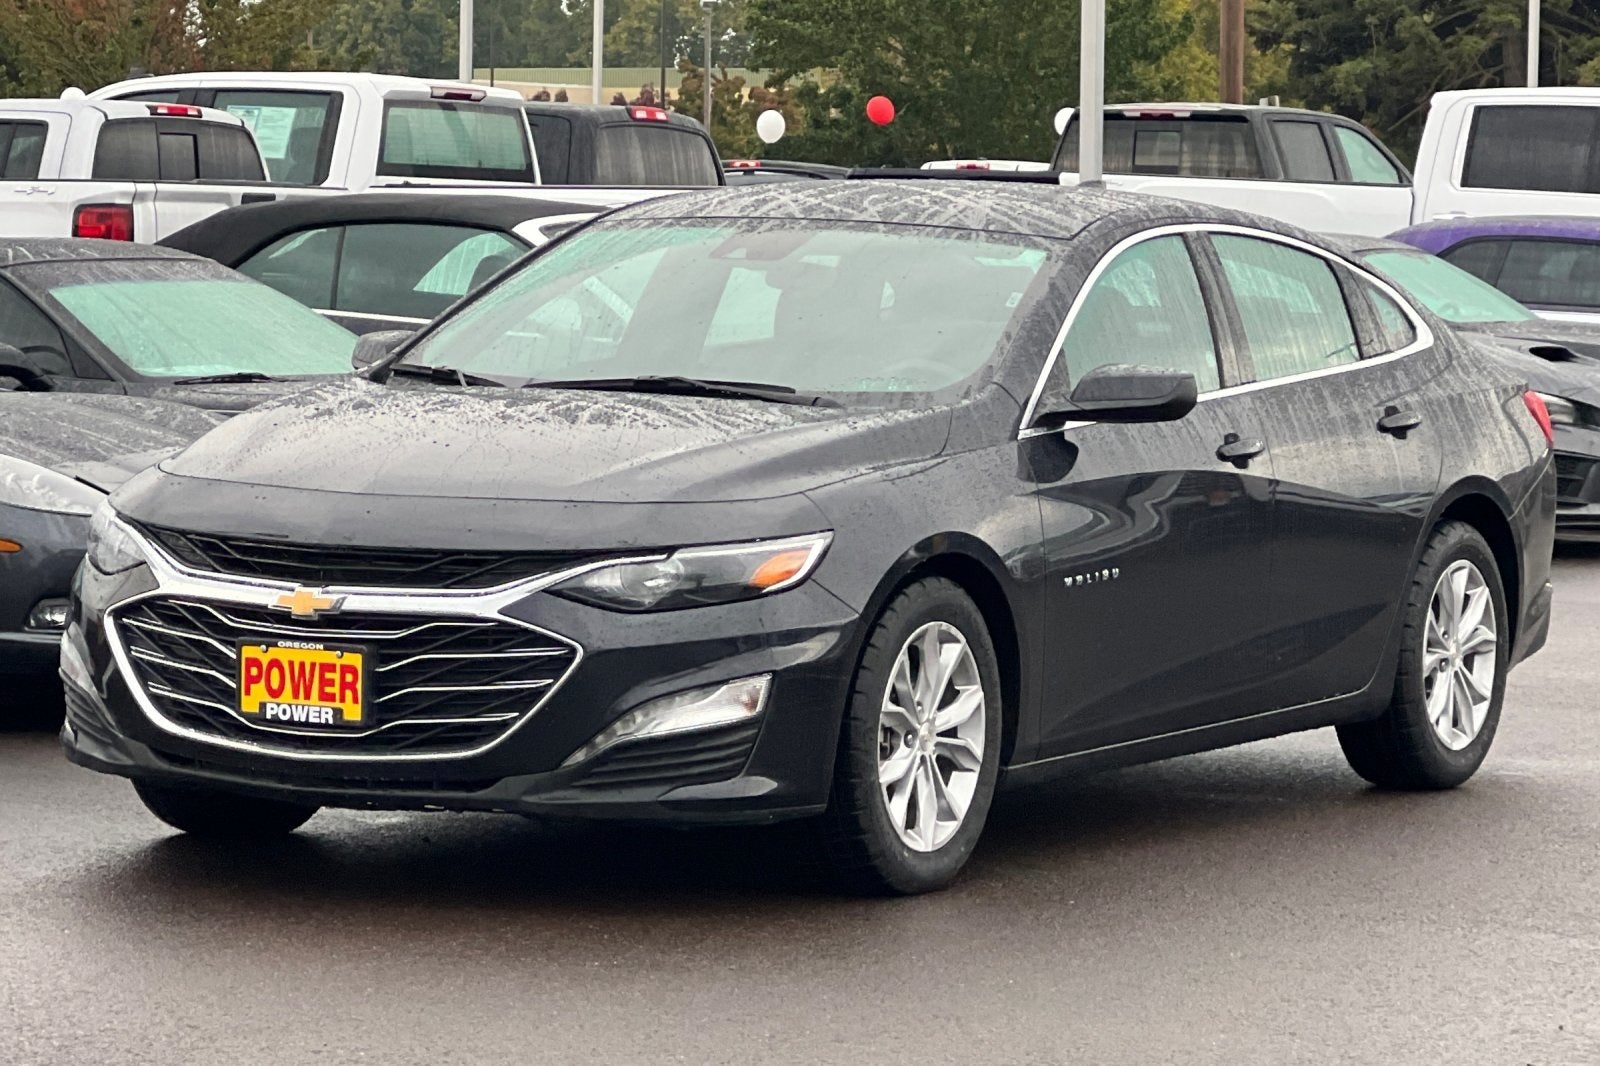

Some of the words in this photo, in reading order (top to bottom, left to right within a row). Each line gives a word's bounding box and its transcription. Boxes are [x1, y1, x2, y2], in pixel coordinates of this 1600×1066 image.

[277, 641, 324, 650] OREGON
[244, 657, 360, 705] POWER
[265, 702, 334, 724] POWER
